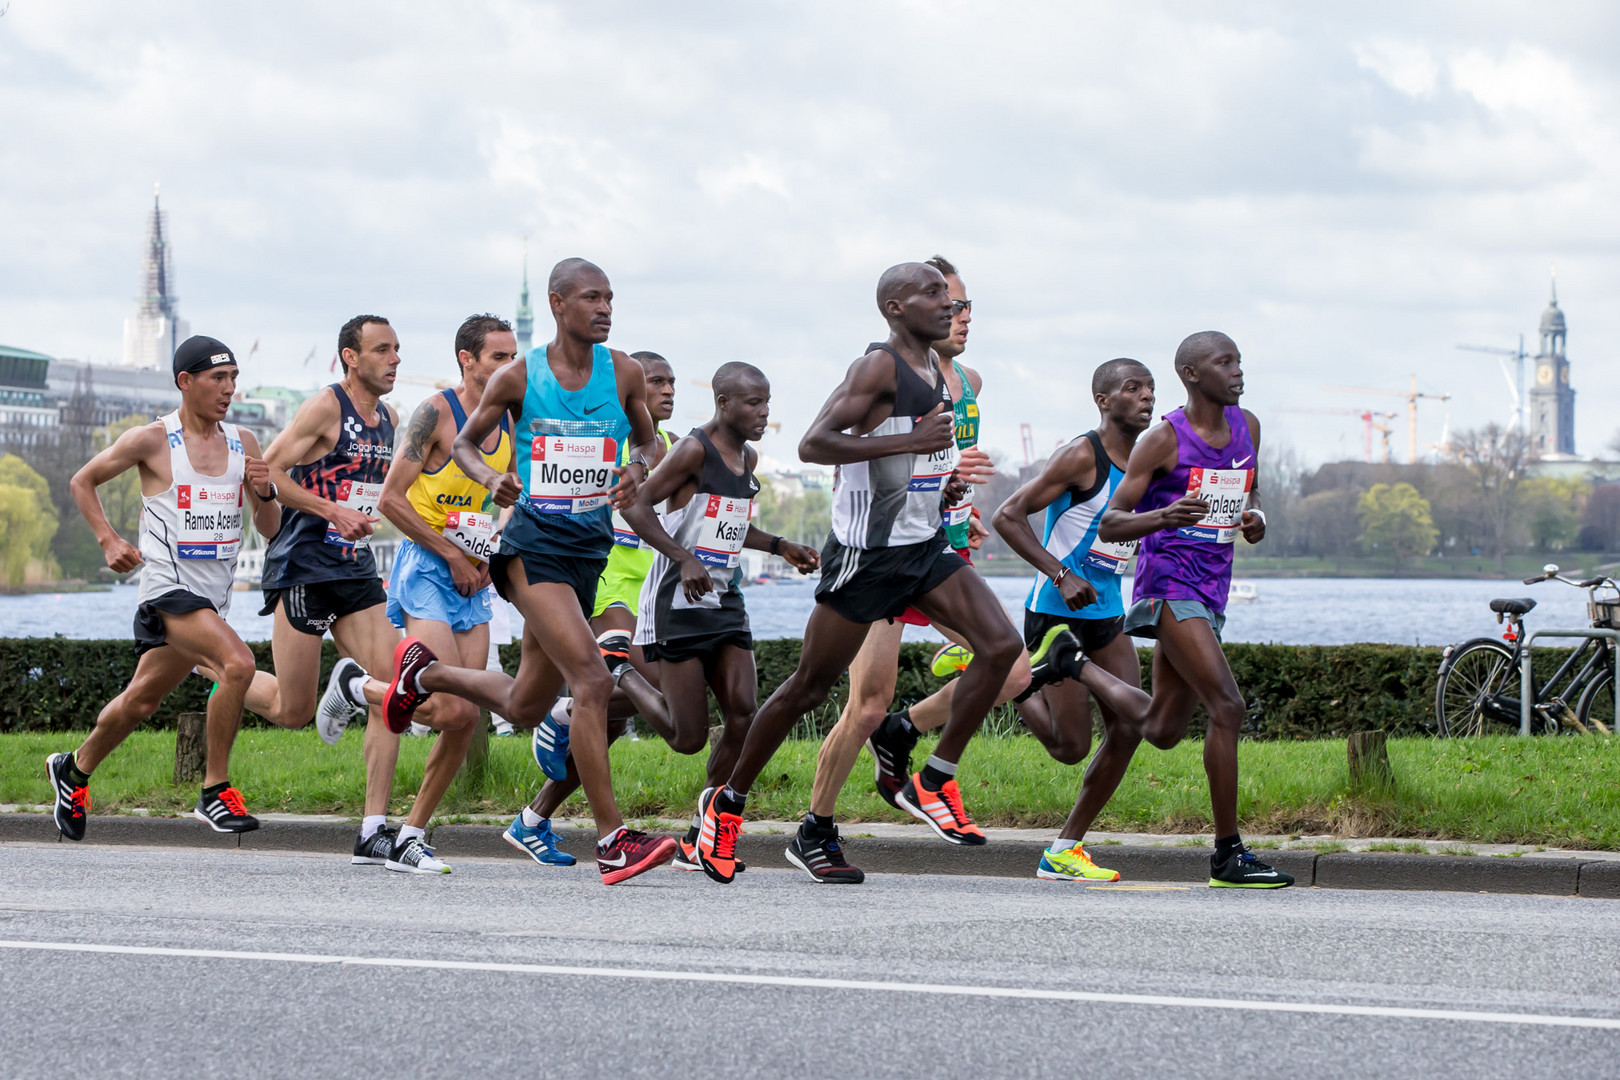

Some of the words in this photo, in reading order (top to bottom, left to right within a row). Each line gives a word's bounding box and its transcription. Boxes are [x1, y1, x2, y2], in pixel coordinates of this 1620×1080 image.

[567, 443, 596, 453] Haspa
[541, 463, 609, 488] Moeng
[1220, 475, 1241, 486] Haspa
[210, 491, 236, 501] Haspa
[570, 487, 581, 495] 12
[436, 493, 472, 507] CAIXA
[578, 498, 600, 507] Mobil
[184, 510, 215, 531] Ramos
[1206, 515, 1229, 525] PACE
[213, 532, 223, 541] 28
